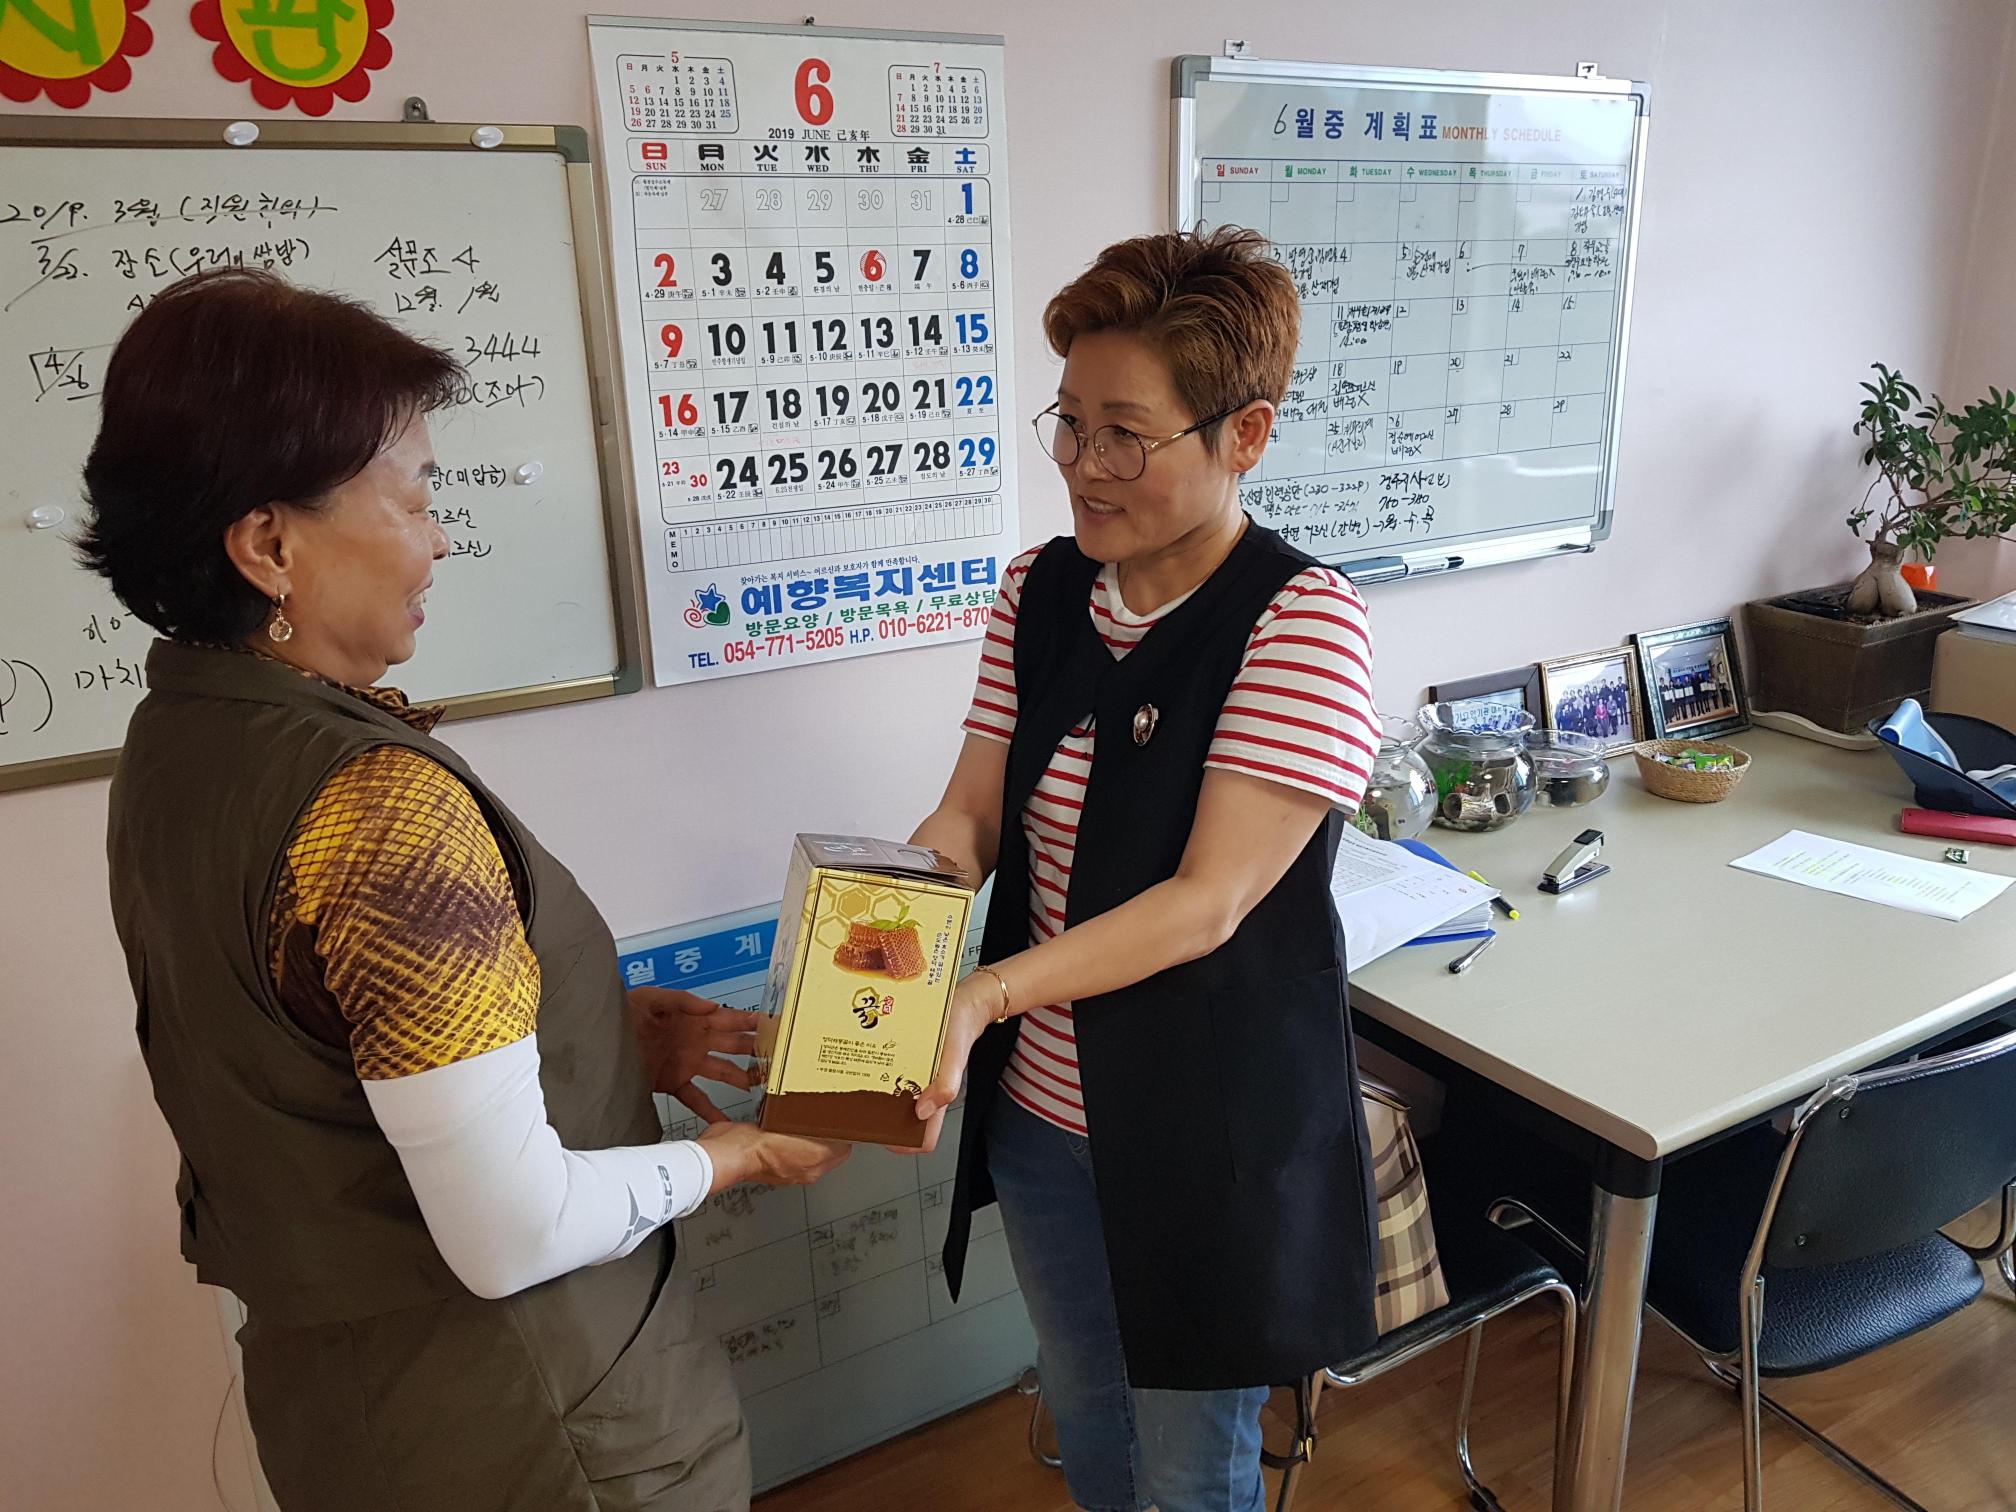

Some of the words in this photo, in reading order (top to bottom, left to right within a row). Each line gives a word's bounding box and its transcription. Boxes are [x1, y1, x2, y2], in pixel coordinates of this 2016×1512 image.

[672, 52, 679, 63] 5
[794, 58, 834, 126] 6
[631, 107, 640, 115] 19
[645, 108, 655, 116] 20
[660, 109, 669, 117] 21
[690, 110, 700, 118] 23
[705, 110, 715, 118] 24
[720, 110, 731, 118] 25
[768, 128, 794, 139] 2019
[802, 130, 830, 140] JUNE
[1364, 111, 1438, 141] 계획표
[1442, 126, 1498, 141] MONTHLY
[1504, 128, 1562, 142] SCHEDULE
[642, 142, 667, 160] 日
[698, 143, 724, 160] 月
[754, 144, 778, 162] 火
[805, 145, 830, 163] 水
[857, 146, 880, 164] 木
[907, 147, 930, 164] 金
[954, 148, 977, 164] 土
[646, 163, 667, 171] SUN
[700, 163, 724, 171] MON
[757, 164, 777, 172] TUE
[859, 165, 880, 173] THU
[1216, 164, 1225, 177] 일
[1230, 167, 1259, 175] SUNDAY
[1297, 167, 1326, 175] MONDAY
[1362, 168, 1392, 176] TUESDAY
[1406, 166, 1415, 178] 수
[700, 188, 728, 211] 27
[756, 189, 782, 211] 28
[807, 189, 833, 211] 29
[858, 190, 883, 211] 30
[911, 190, 931, 211] 31
[962, 182, 972, 214] 1
[1340, 247, 1347, 262] 4
[1402, 244, 1408, 260] 5
[1459, 241, 1465, 259] 6
[1518, 244, 1524, 261] 7
[654, 253, 677, 287] 2
[711, 252, 732, 286] 3
[765, 252, 786, 285] 4
[815, 252, 834, 284] 5
[864, 250, 882, 281] 6
[913, 250, 932, 281] 7
[960, 249, 979, 279] 8
[1396, 305, 1407, 317] 12
[1456, 299, 1464, 311] 13
[1512, 299, 1520, 312] 14
[1563, 296, 1575, 310] 15
[661, 324, 683, 358] 9
[708, 323, 745, 356] 10
[763, 321, 797, 354] 11
[812, 319, 847, 351] 12
[861, 317, 894, 349] 13
[908, 314, 942, 346] 14
[956, 313, 988, 344] 15
[1333, 362, 1343, 376] 18
[1450, 358, 1461, 367] 20
[1505, 354, 1514, 365] 21
[1559, 351, 1571, 360] 22
[658, 394, 698, 427] 16
[714, 390, 749, 424] 17
[766, 389, 801, 420] 18
[816, 385, 849, 416] 19
[862, 382, 900, 413] 20
[912, 379, 945, 409] 21
[955, 375, 993, 406] 22
[1447, 408, 1458, 425] 27
[1500, 404, 1512, 415] 28
[1553, 400, 1565, 413] 29
[662, 461, 680, 475] 23
[716, 456, 759, 490] 24
[768, 452, 808, 485] 25
[818, 448, 857, 480] 26
[867, 444, 903, 476] 27
[914, 441, 950, 472] 28
[959, 437, 995, 468] 29
[690, 474, 707, 488] 30
[770, 570, 784, 581] 복지
[843, 560, 869, 571] 보호자가
[871, 558, 884, 568] 함께
[741, 556, 996, 615] 예향복지센터
[746, 613, 820, 637] 방문요양
[841, 601, 909, 623] 방문목욕
[930, 590, 997, 610] 무료상담
[688, 652, 719, 668] TEL.
[724, 626, 844, 663] 054-771-5205
[850, 628, 874, 644] H.P.
[879, 606, 992, 639] 010-6221-870
